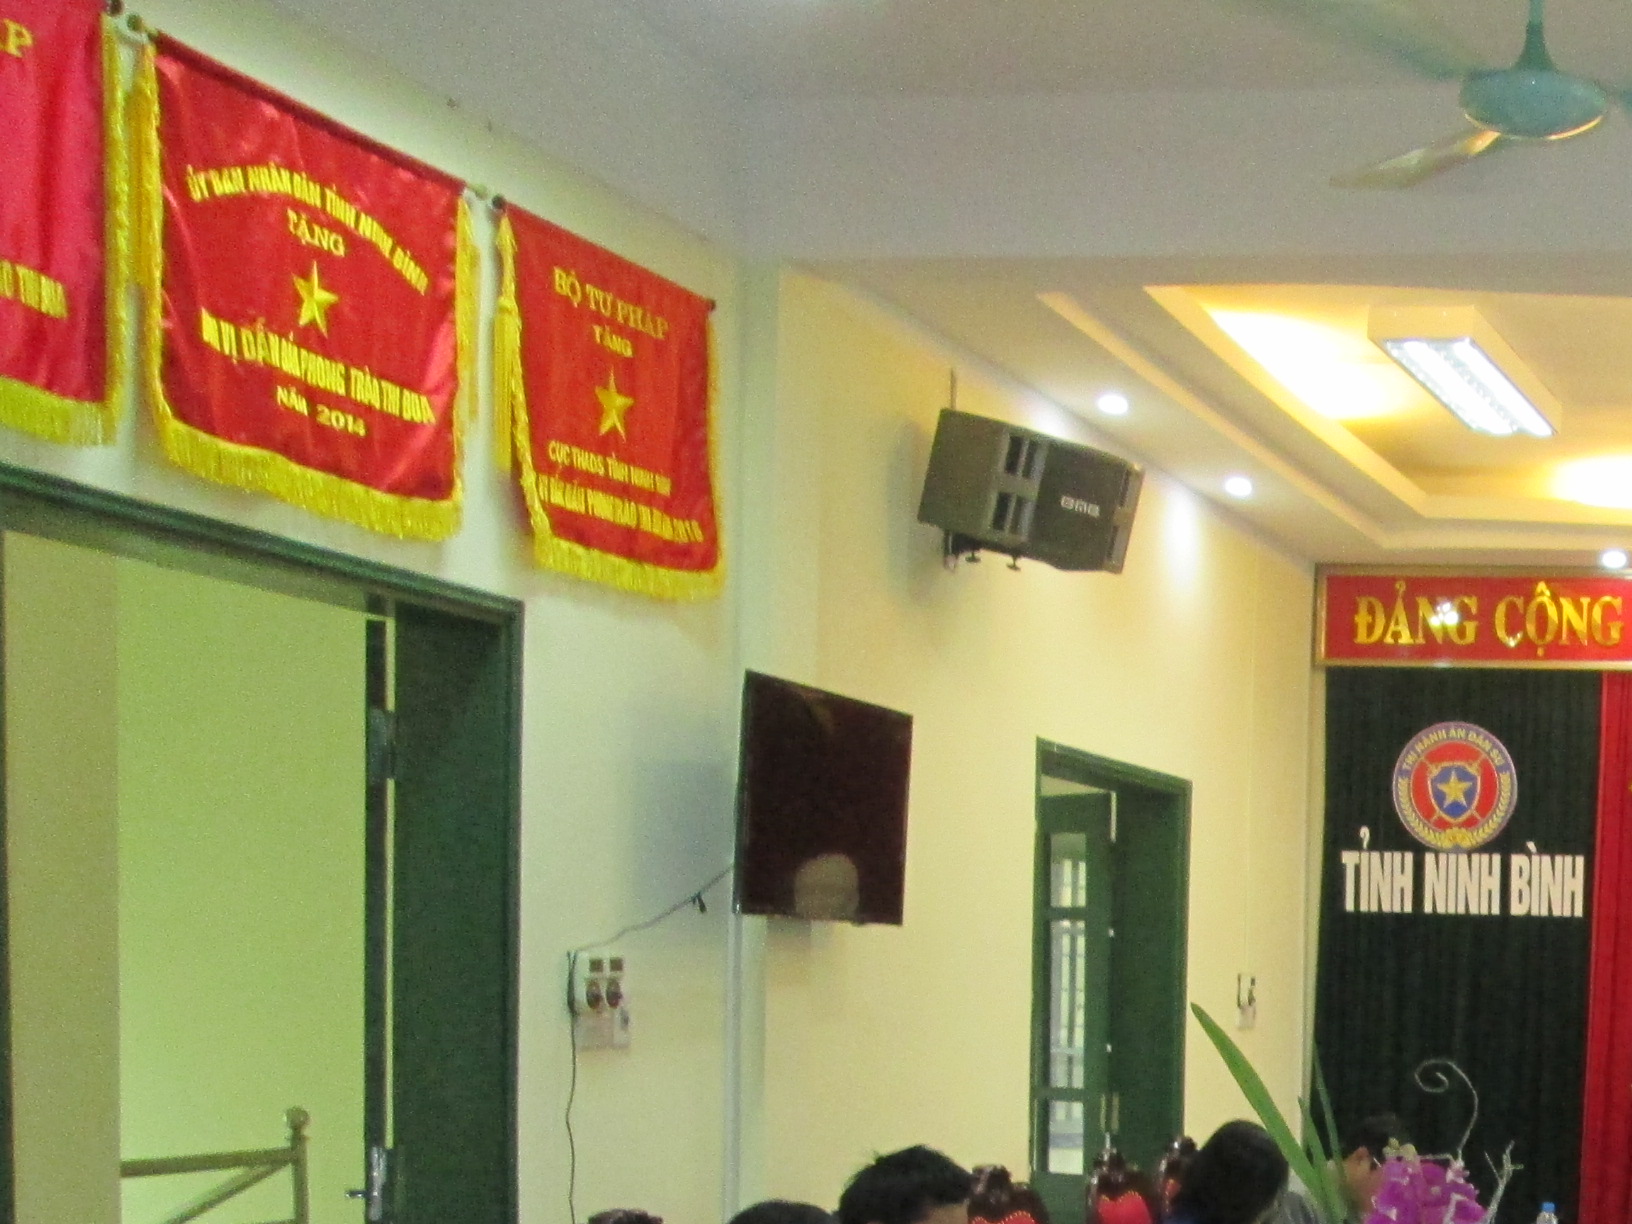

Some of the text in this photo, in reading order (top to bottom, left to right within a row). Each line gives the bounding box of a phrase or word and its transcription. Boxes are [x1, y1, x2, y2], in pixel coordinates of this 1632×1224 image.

[1354, 580, 1479, 645] ĐẢNG
[1494, 581, 1624, 657] CỘNG
[1341, 826, 1584, 917] TỈNH NINH BÌNH
